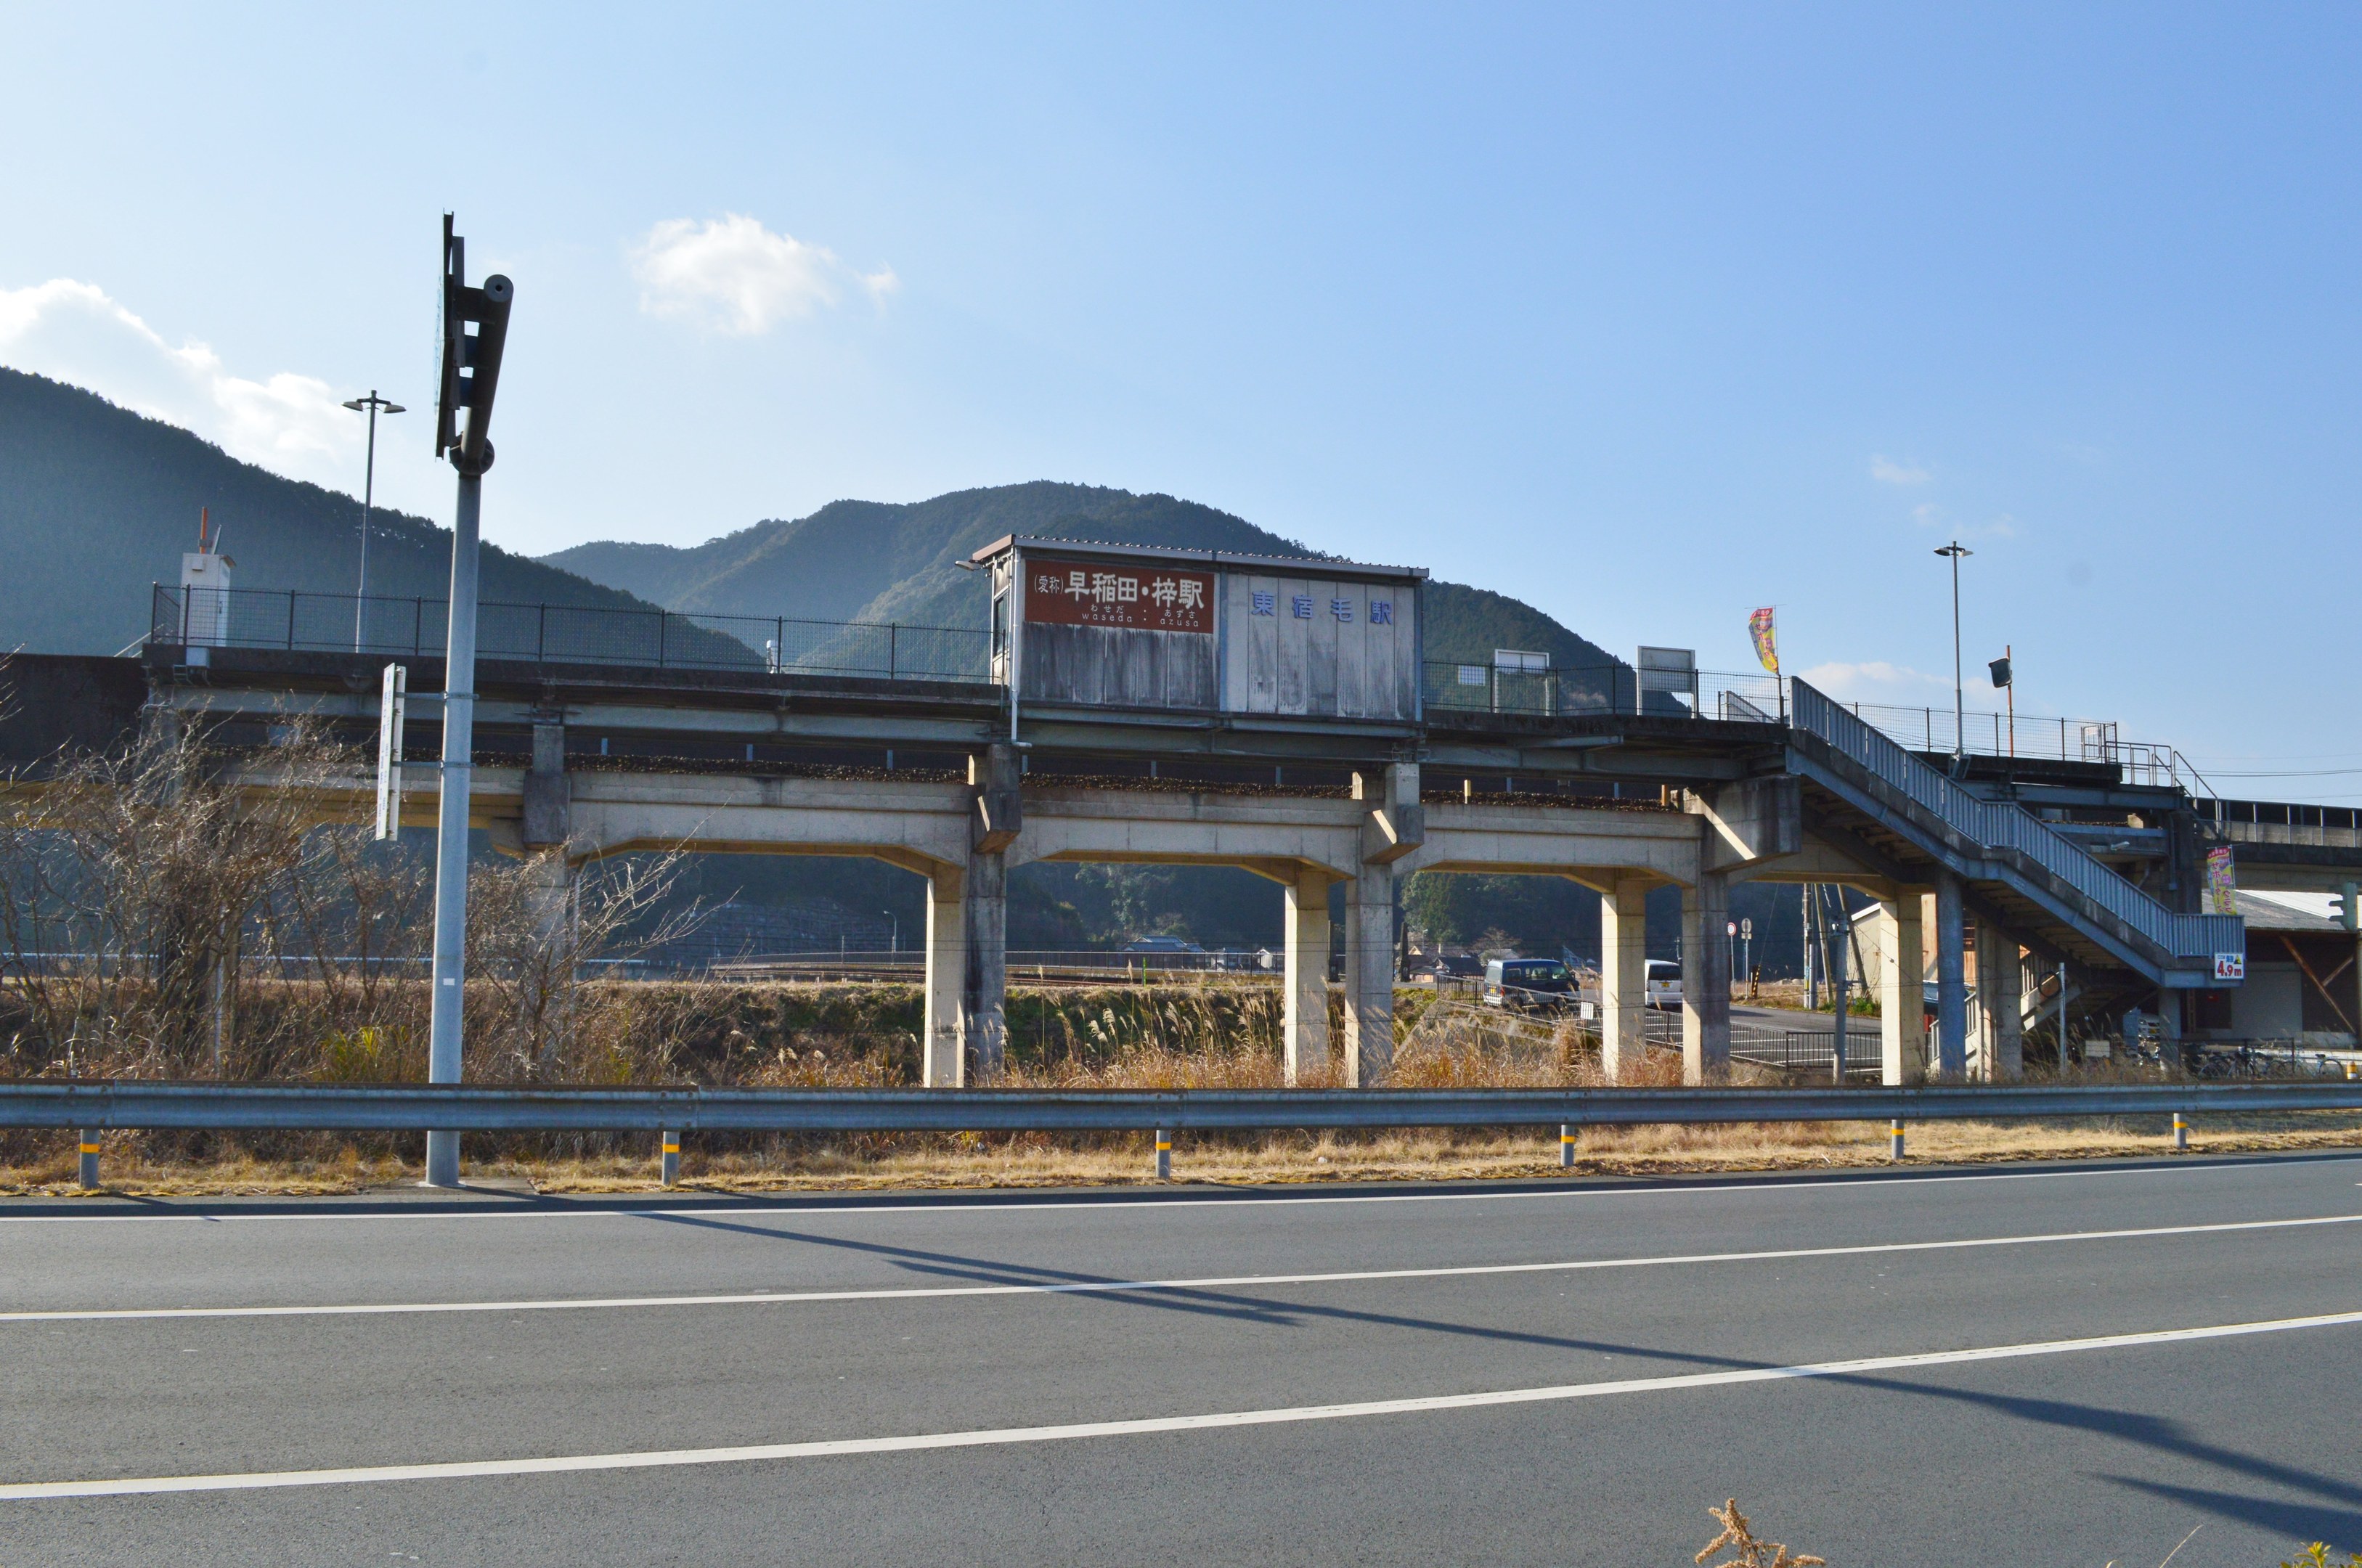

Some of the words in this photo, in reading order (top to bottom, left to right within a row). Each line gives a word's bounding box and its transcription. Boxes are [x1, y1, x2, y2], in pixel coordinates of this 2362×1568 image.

[1252, 590, 1393, 625] 東宿毛駅
[1082, 613, 1133, 623] waseda
[1160, 618, 1200, 627] azusa
